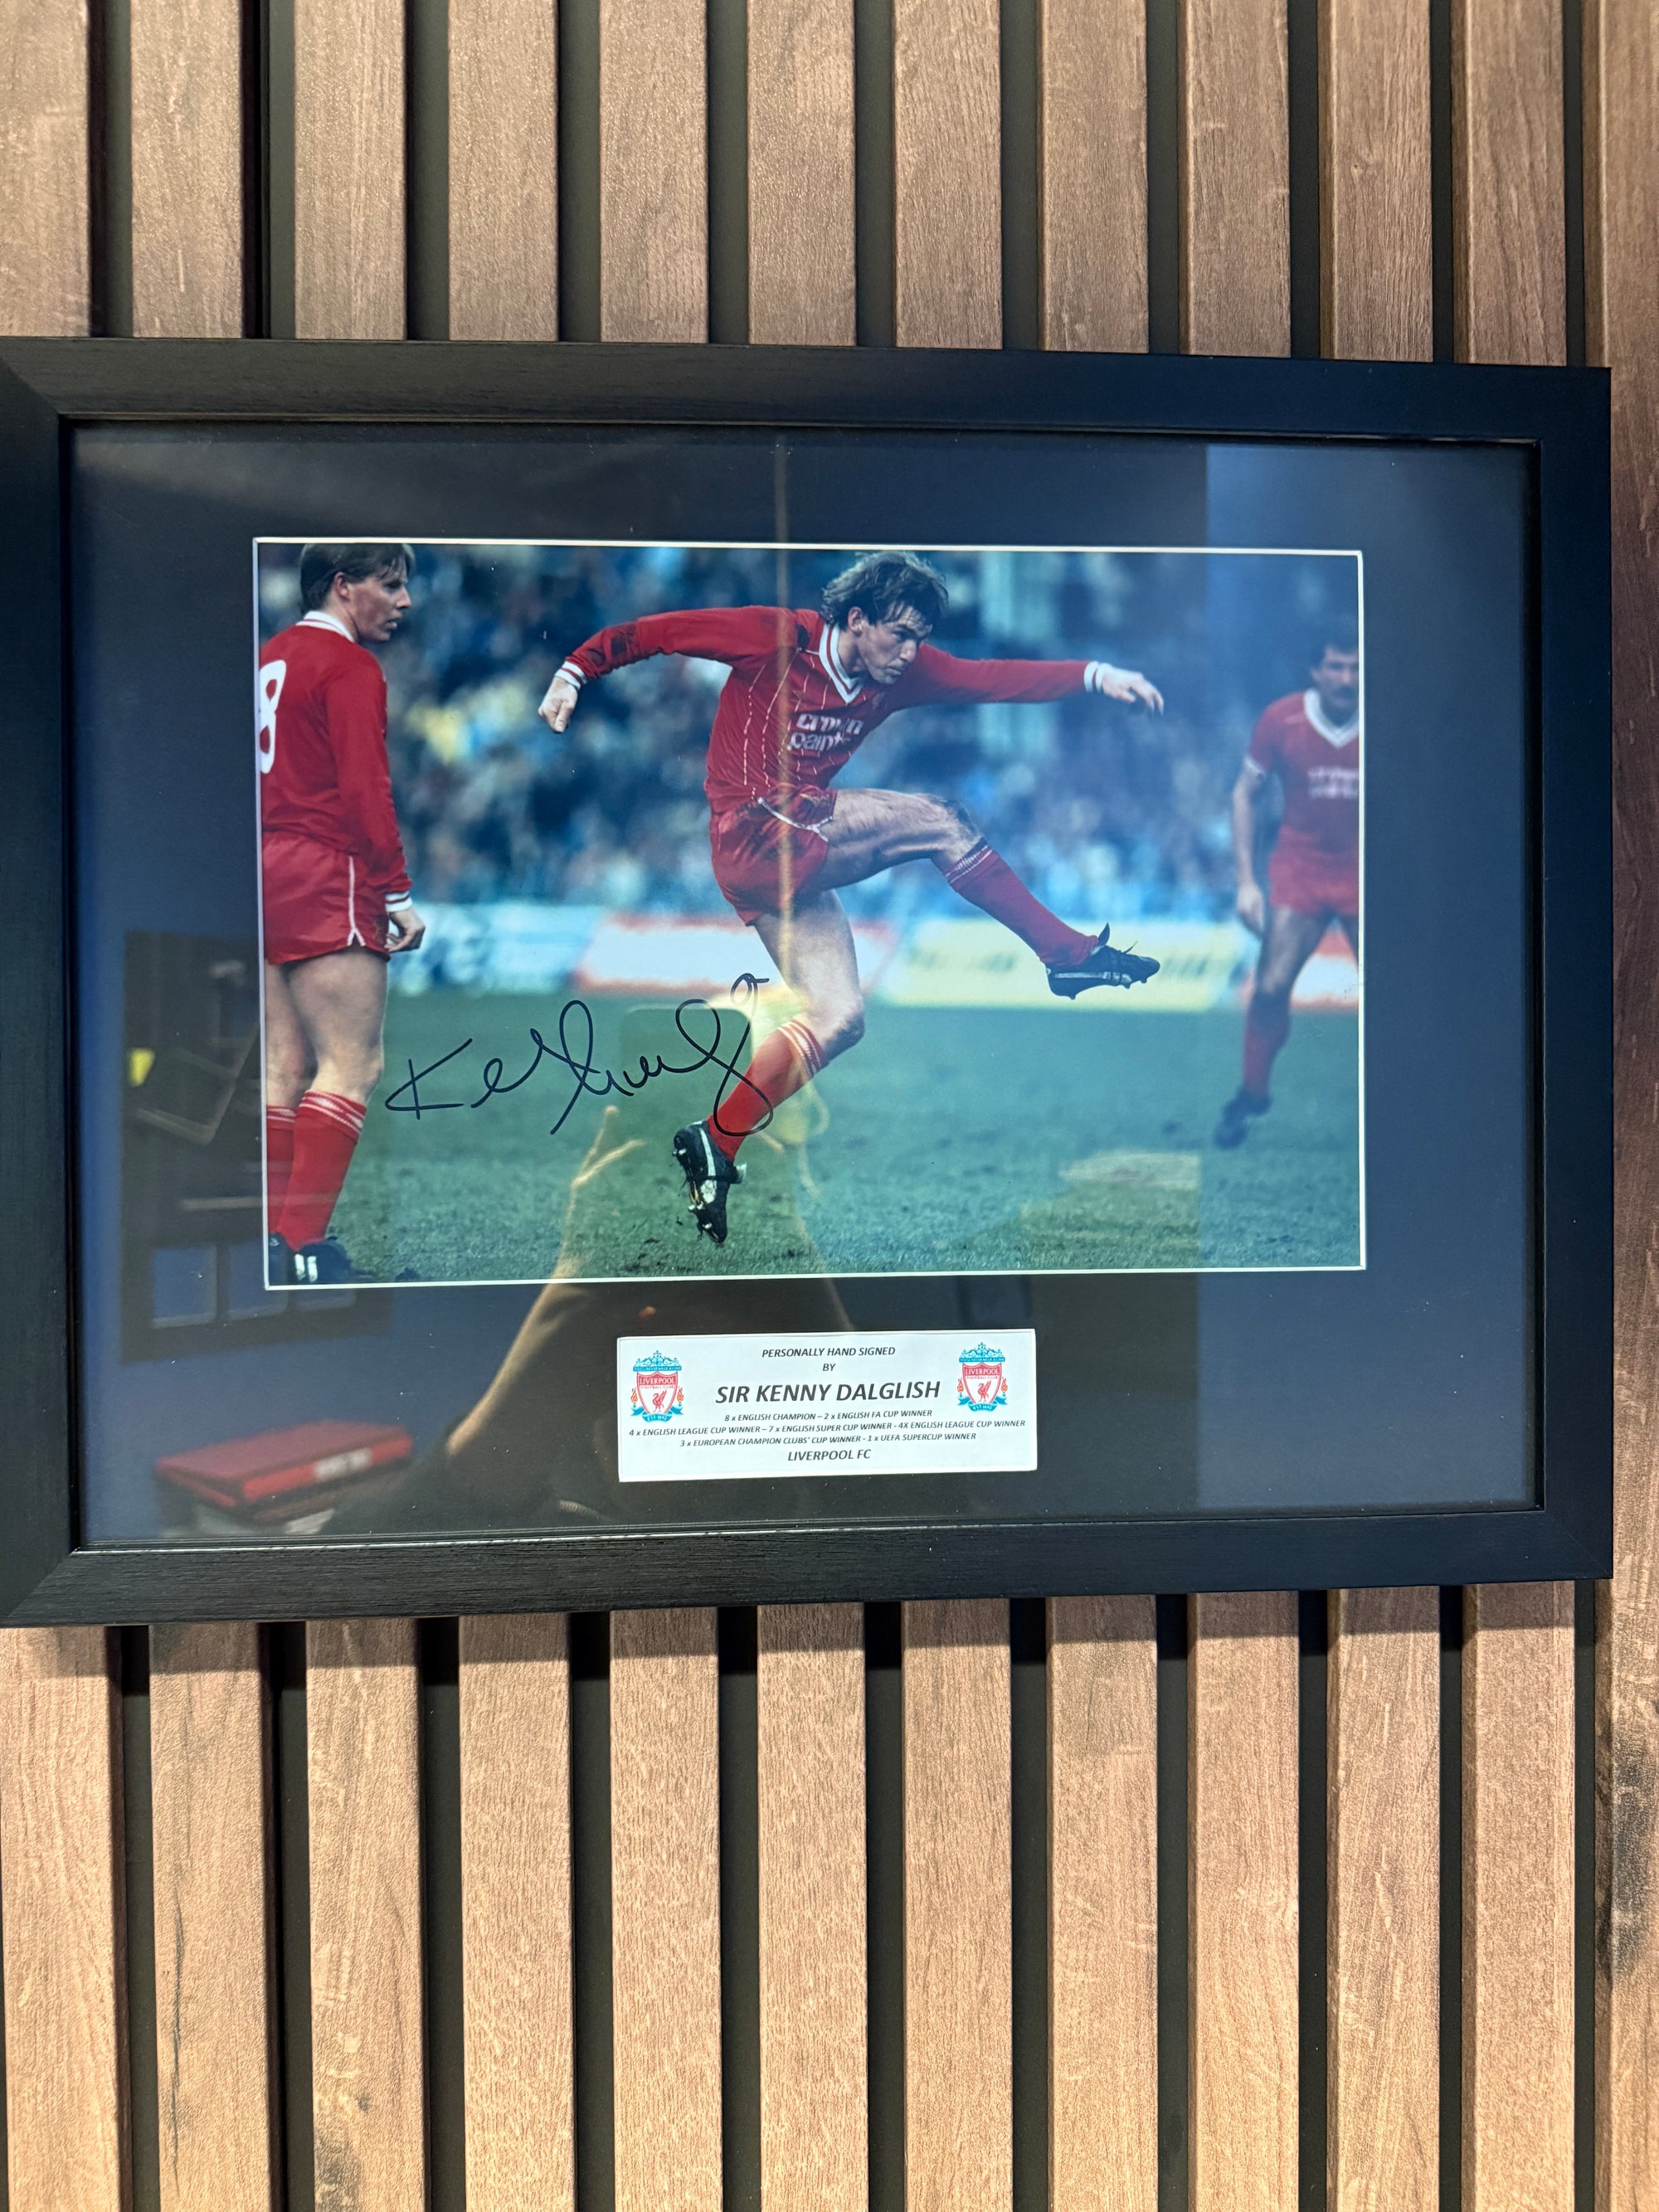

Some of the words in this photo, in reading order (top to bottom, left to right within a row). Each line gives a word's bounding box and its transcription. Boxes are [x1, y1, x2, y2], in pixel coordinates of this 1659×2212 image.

[762, 1348, 824, 1358] PERSONALLY
[827, 1348, 856, 1356] HAND
[859, 1347, 895, 1355] SIGNED
[716, 1386, 750, 1403] SIR
[757, 1384, 832, 1402] KENNY
[836, 1381, 940, 1401] DALGLISH
[788, 1450, 854, 1461] LIVERPOOL
[857, 1449, 871, 1459] FC
